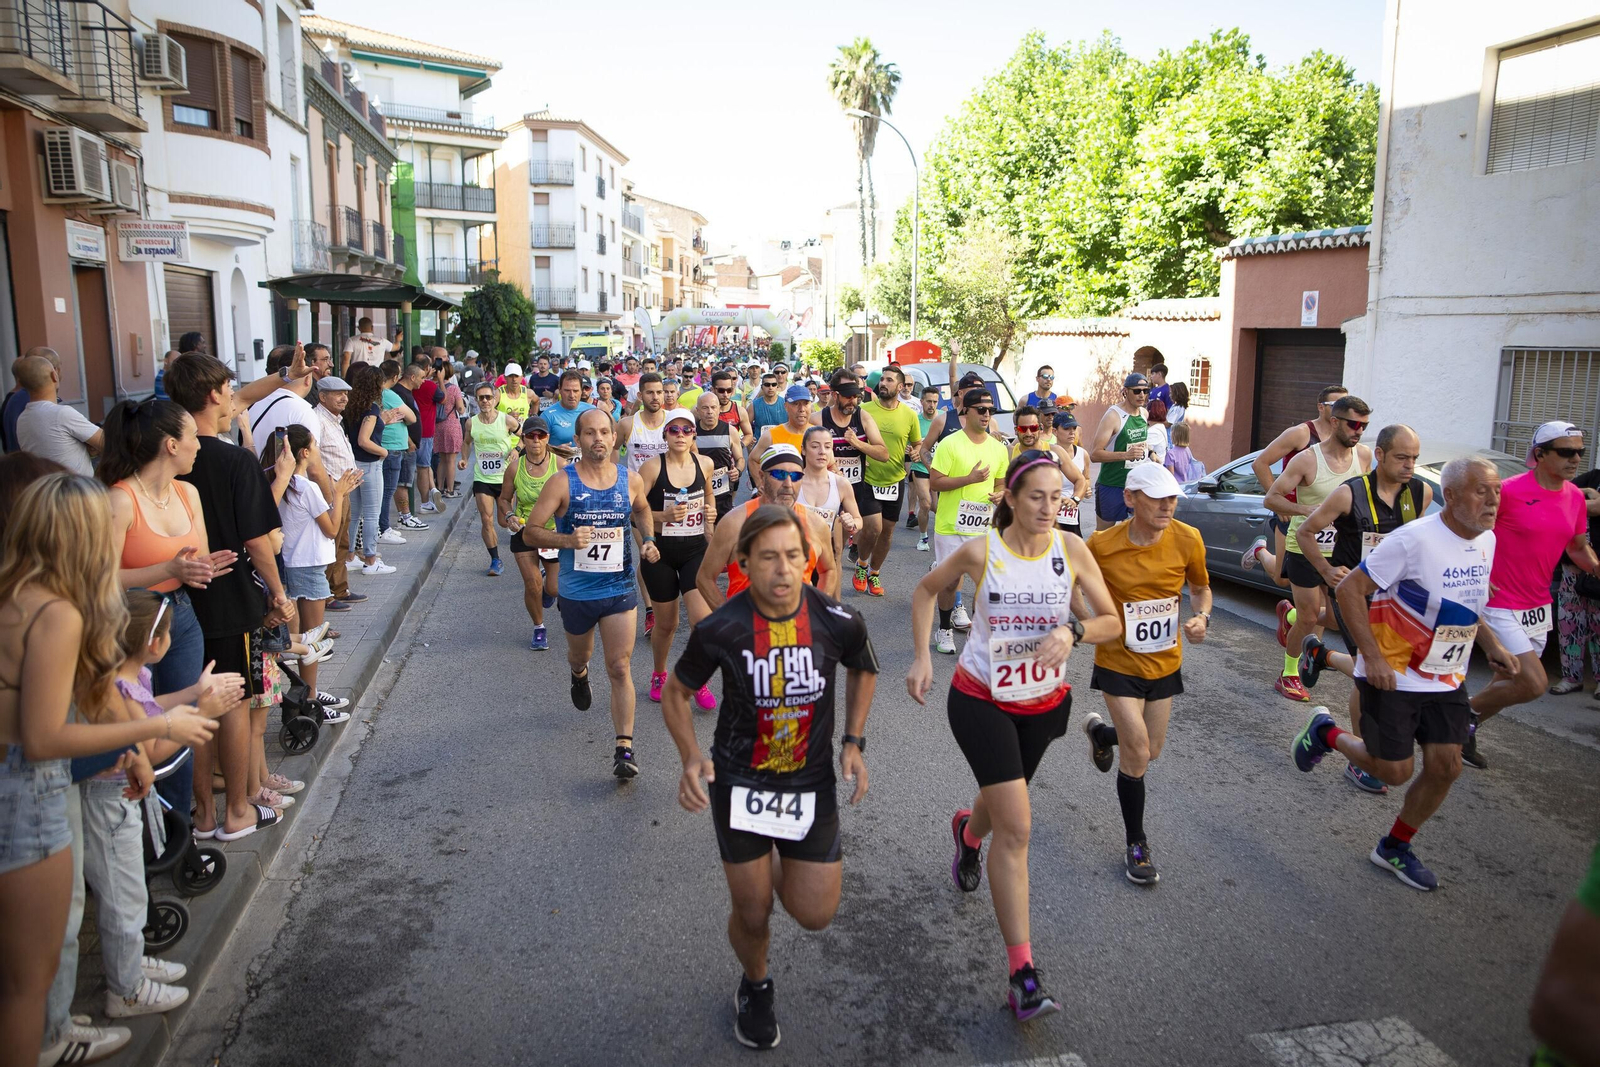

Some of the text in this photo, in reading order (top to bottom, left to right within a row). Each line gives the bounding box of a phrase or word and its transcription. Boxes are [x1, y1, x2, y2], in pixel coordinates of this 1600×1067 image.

[482, 460, 501, 470] 805
[874, 486, 897, 494] 3072
[966, 503, 988, 511] FONDO
[958, 514, 990, 527] 3004
[1316, 530, 1336, 543] 22
[588, 544, 611, 560] 47
[1138, 604, 1171, 614] FONDO
[1522, 607, 1546, 627] 480
[1136, 618, 1170, 642] 601
[1008, 642, 1040, 654] FOND
[1442, 644, 1466, 662] 41
[756, 698, 780, 708] XXIV
[746, 788, 803, 820] 644
